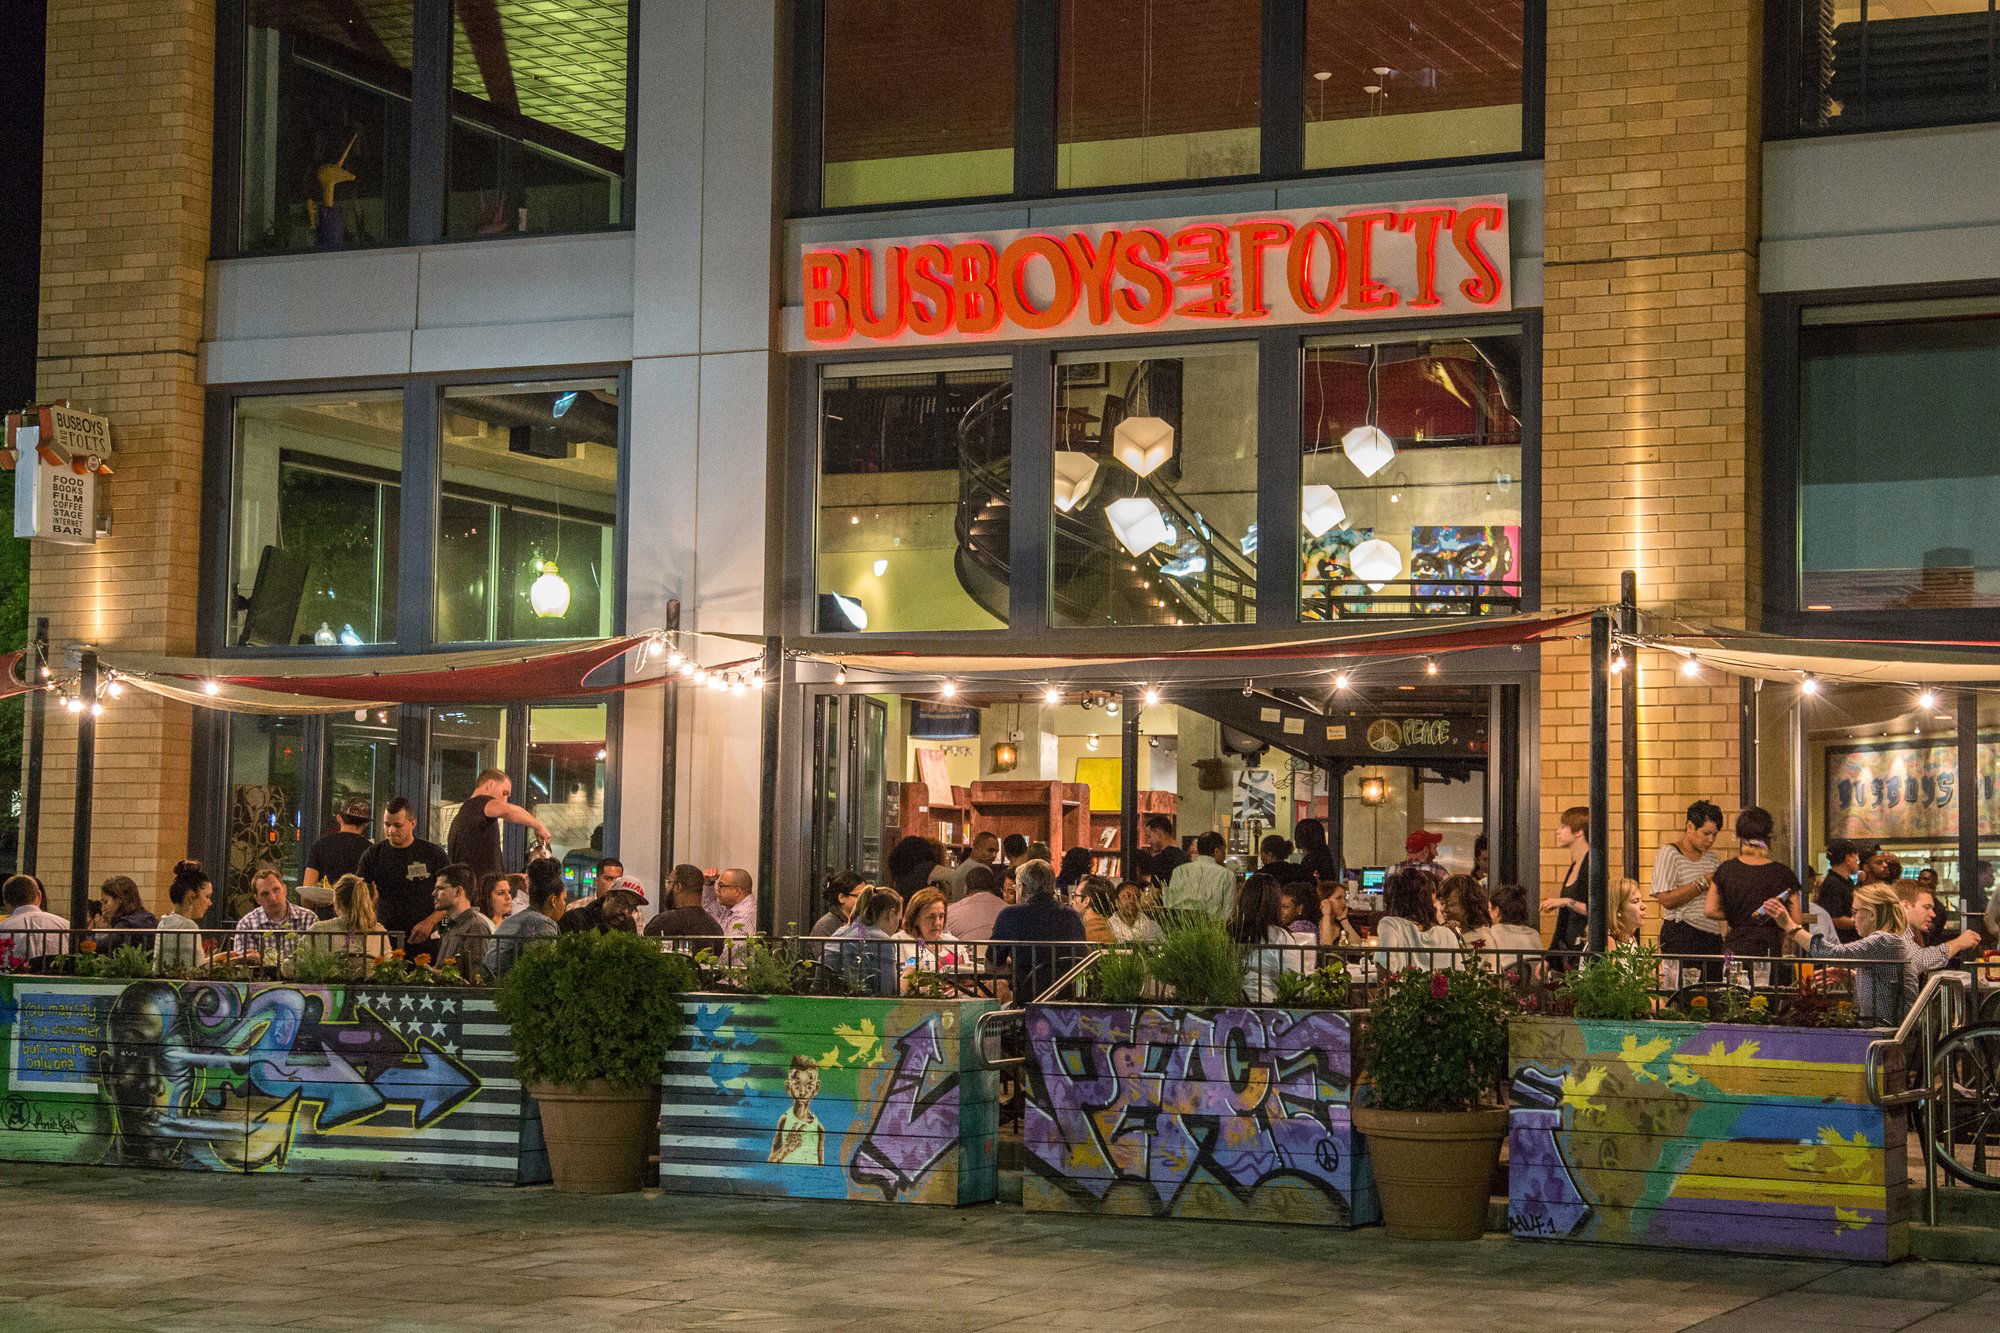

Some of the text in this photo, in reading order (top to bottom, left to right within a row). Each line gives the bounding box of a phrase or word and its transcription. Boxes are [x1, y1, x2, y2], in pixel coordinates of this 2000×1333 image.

[802, 202, 1503, 343] BUSBOYS AND POETS
[57, 413, 103, 436] BUSBOYS
[68, 431, 106, 452] POETS
[53, 475, 84, 486] FOOD
[53, 484, 83, 495] BOOKS
[53, 492, 83, 503] FILM
[53, 500, 83, 511] COFFEE
[53, 508, 83, 520] STAGE
[53, 517, 83, 528] INTERNET
[53, 525, 82, 536] BAR
[1403, 719, 1450, 746] PEACE
[1838, 772, 1954, 809] BUSBOYS
[24, 1001, 97, 1021] You may say
[22, 1043, 42, 1055] but
[60, 1042, 76, 1056] not
[78, 1042, 97, 1057] the
[53, 1058, 75, 1071] one
